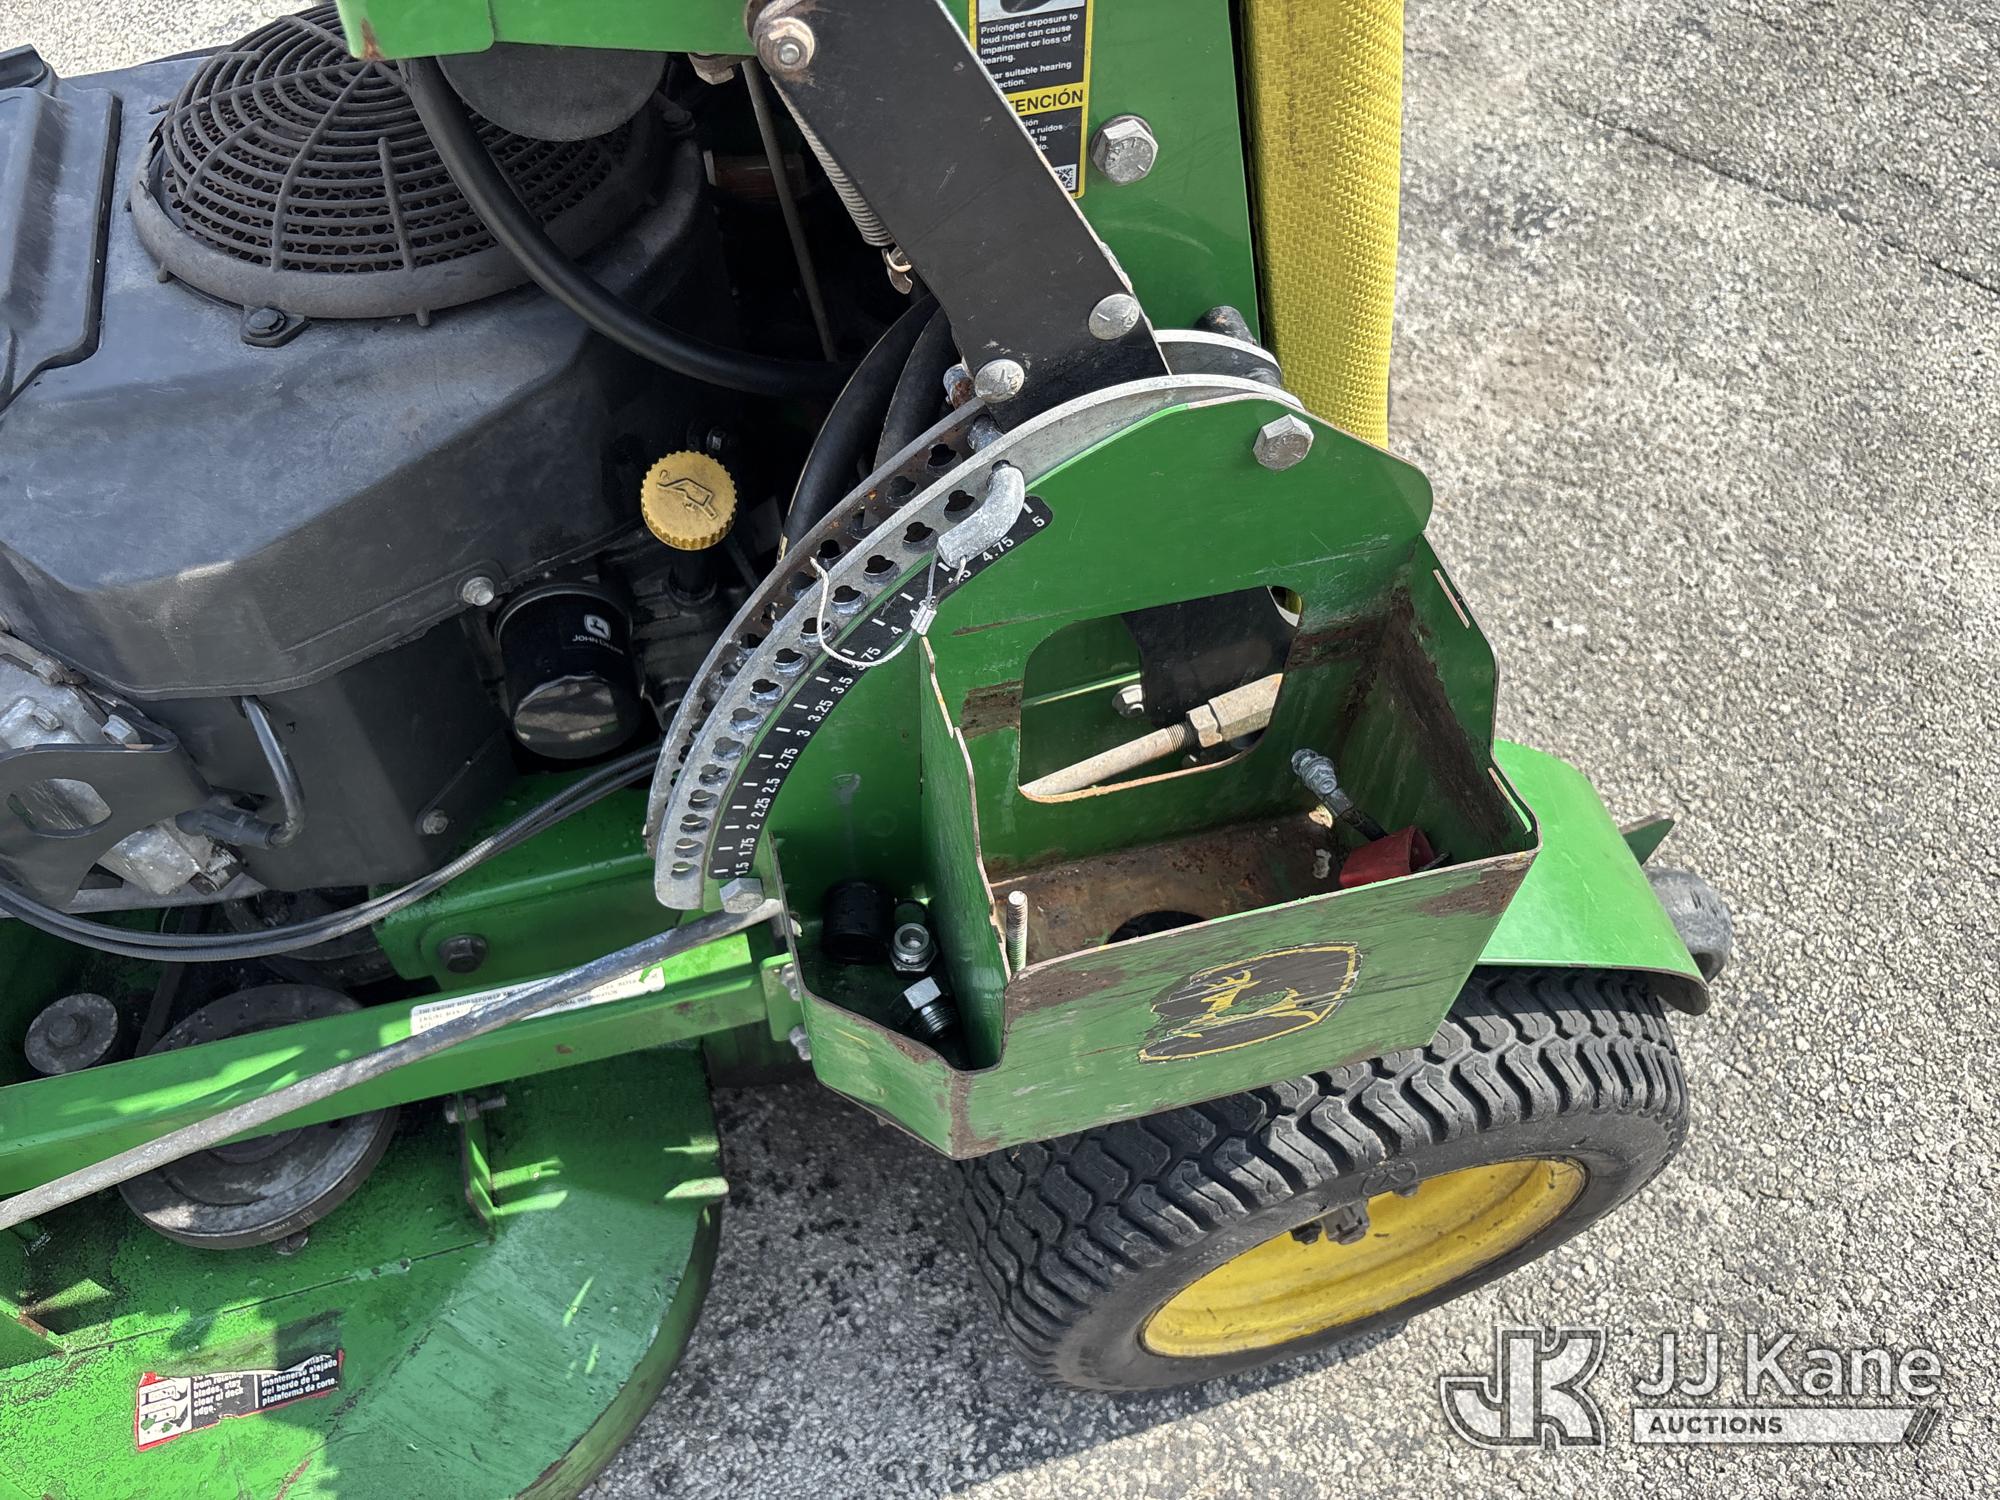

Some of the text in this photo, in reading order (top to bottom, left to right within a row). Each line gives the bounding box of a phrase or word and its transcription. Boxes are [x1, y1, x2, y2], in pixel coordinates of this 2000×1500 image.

[981, 13, 1079, 35] Prolonged exposure to
[981, 25, 1072, 45] loud noise can cause
[981, 41, 1029, 55] impairment
[1042, 36, 1060, 45] loss
[1062, 34, 1072, 42] of
[981, 54, 1016, 65] hearing.
[1005, 66, 1038, 78] suitable
[1040, 61, 1072, 73] hearing
[1037, 124, 1063, 133] ruidos
[1032, 515, 1045, 528] 5
[981, 536, 1015, 563] 4.75
[890, 625, 904, 635] 4
[572, 634, 599, 644] JOHN
[830, 676, 854, 694] 3.5
[807, 699, 834, 723] 3.25
[796, 729, 811, 737] 3
[775, 747, 799, 770] 2.75
[762, 778, 781, 794] 2.5
[751, 798, 771, 818] 2.25
[746, 823, 761, 831] 2
[738, 837, 756, 856] 1.75
[734, 862, 750, 876] 1.5
[262, 1385, 275, 1396] del
[276, 1380, 299, 1392] borde
[300, 1376, 311, 1385] de
[316, 1378, 338, 1389] corte.
[225, 1387, 244, 1398] deck
